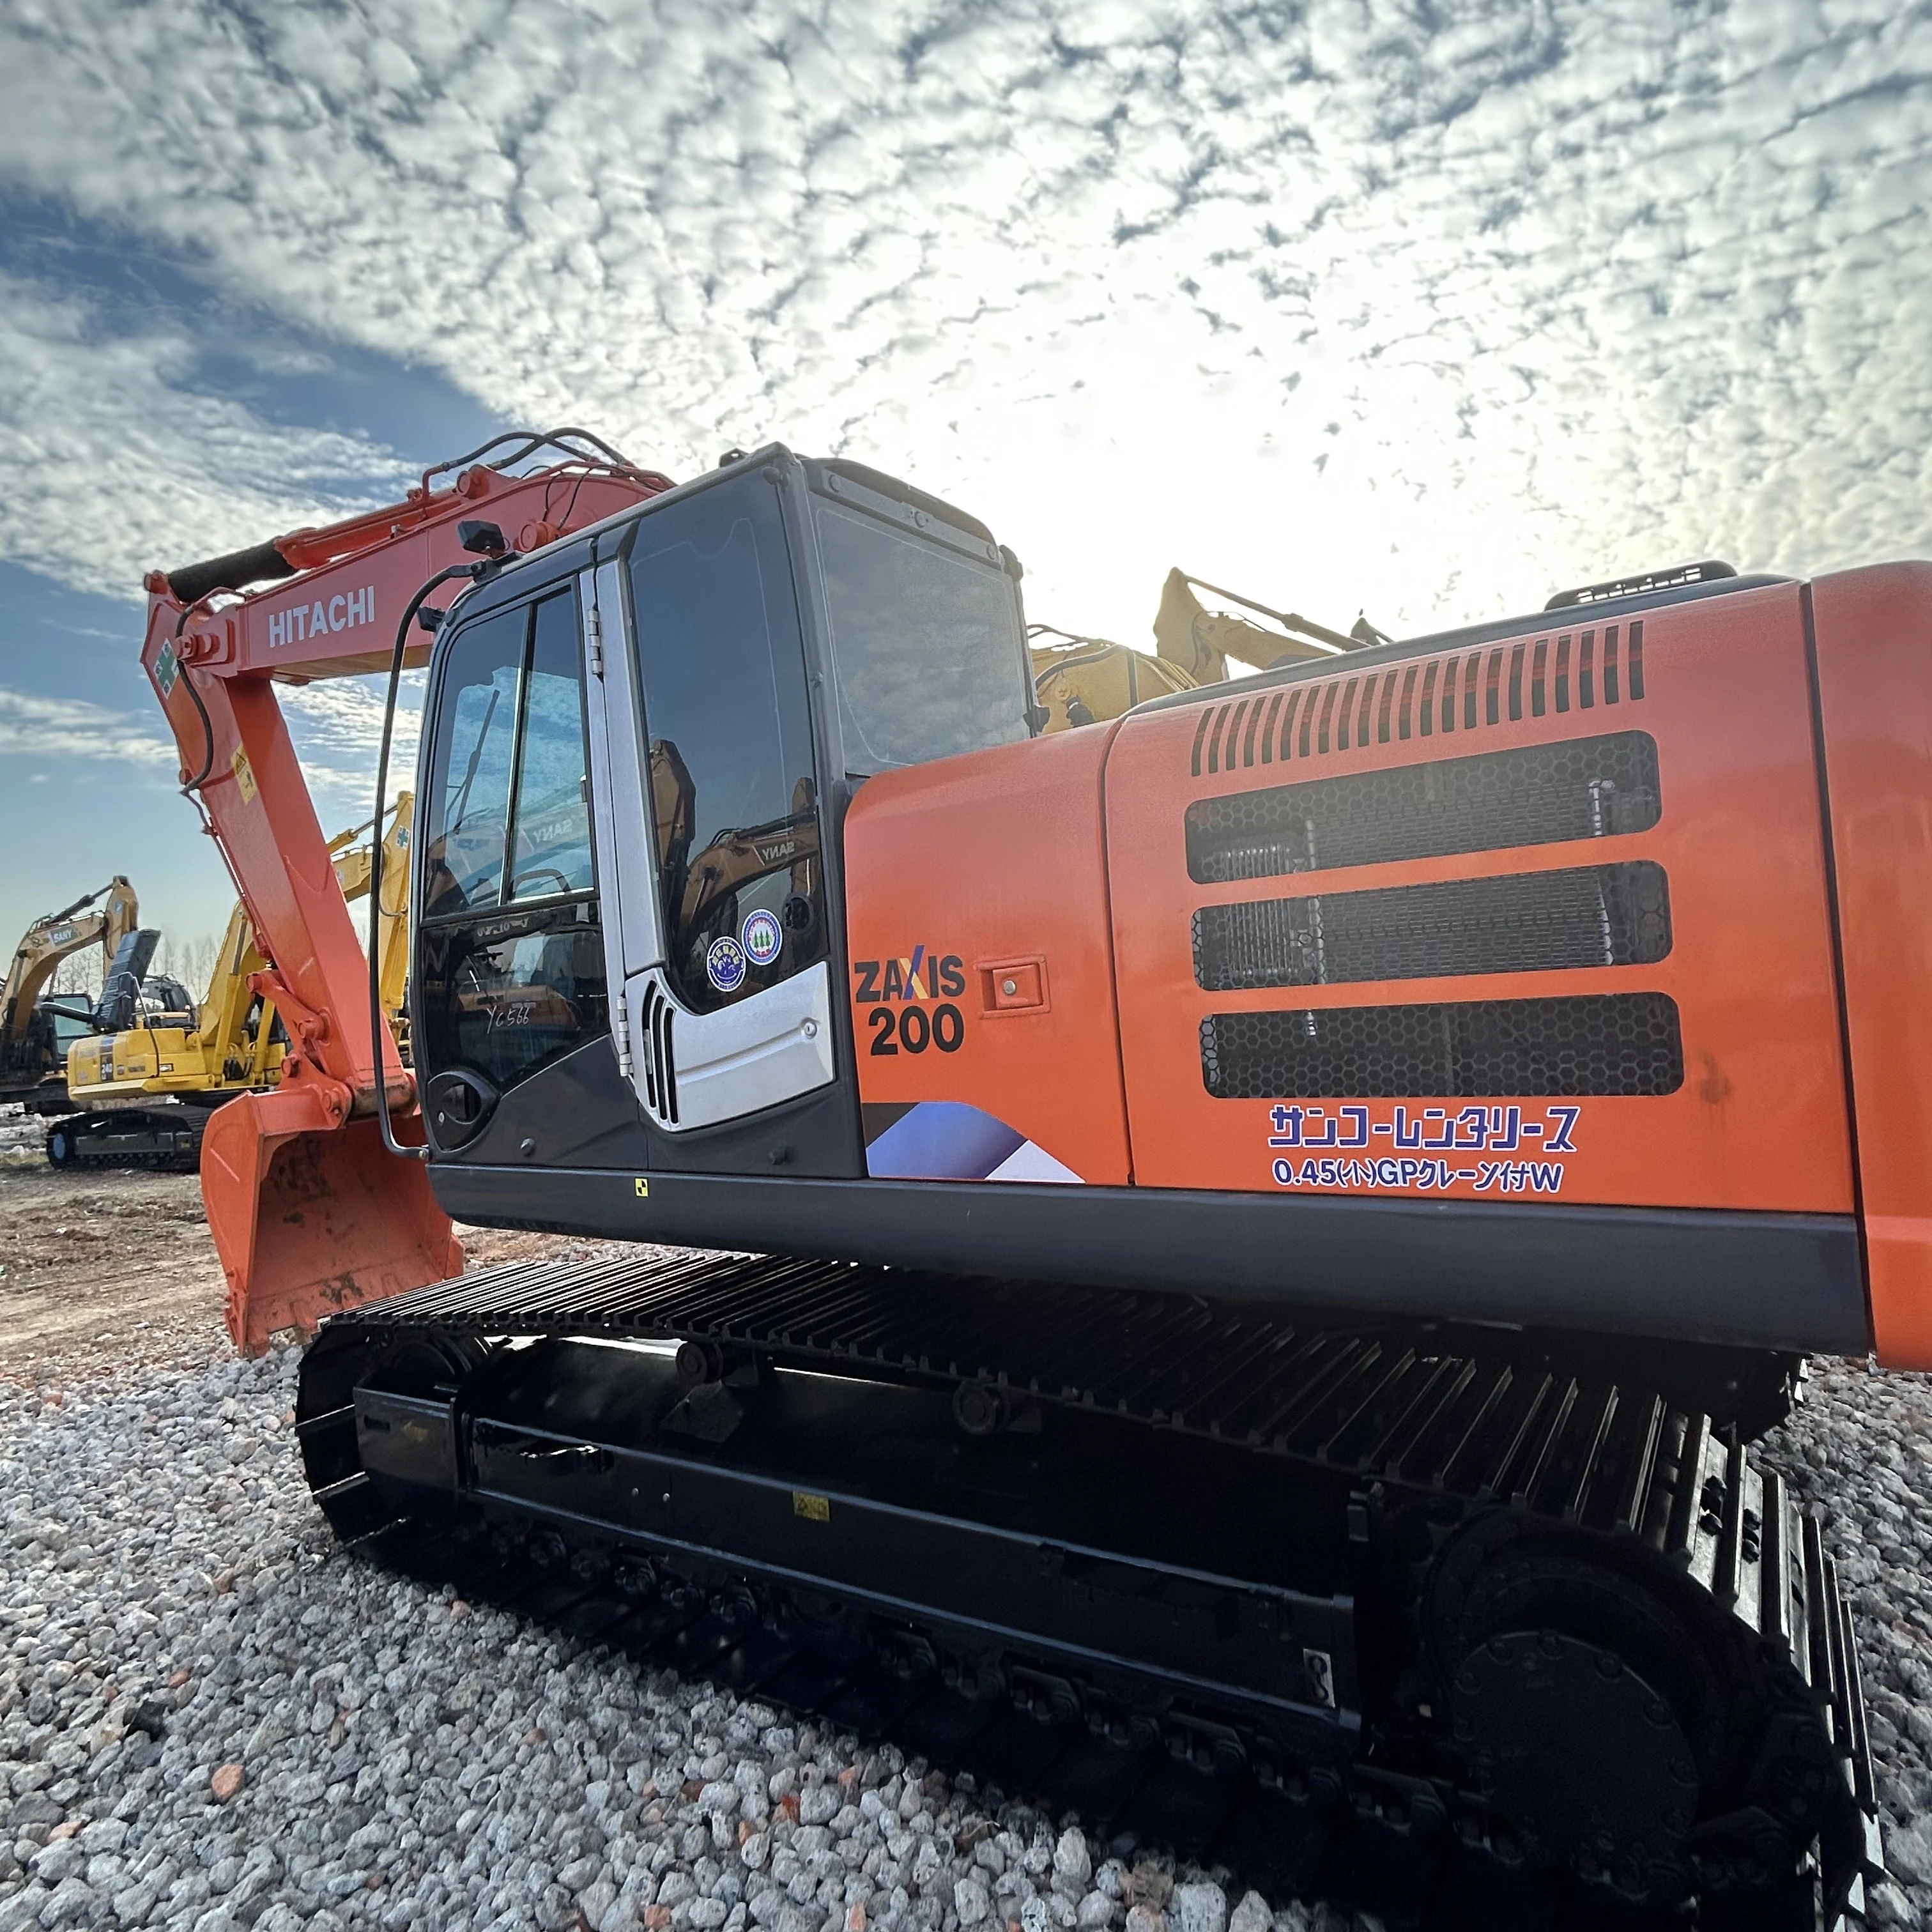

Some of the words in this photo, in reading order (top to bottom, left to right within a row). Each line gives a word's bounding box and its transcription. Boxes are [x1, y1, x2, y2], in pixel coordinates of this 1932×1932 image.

[269, 585, 375, 648] HITACHI
[854, 944, 966, 1003] ZAXIS
[869, 1003, 965, 1056] 200
[1268, 1105, 1581, 1152] サンコーレンタリース
